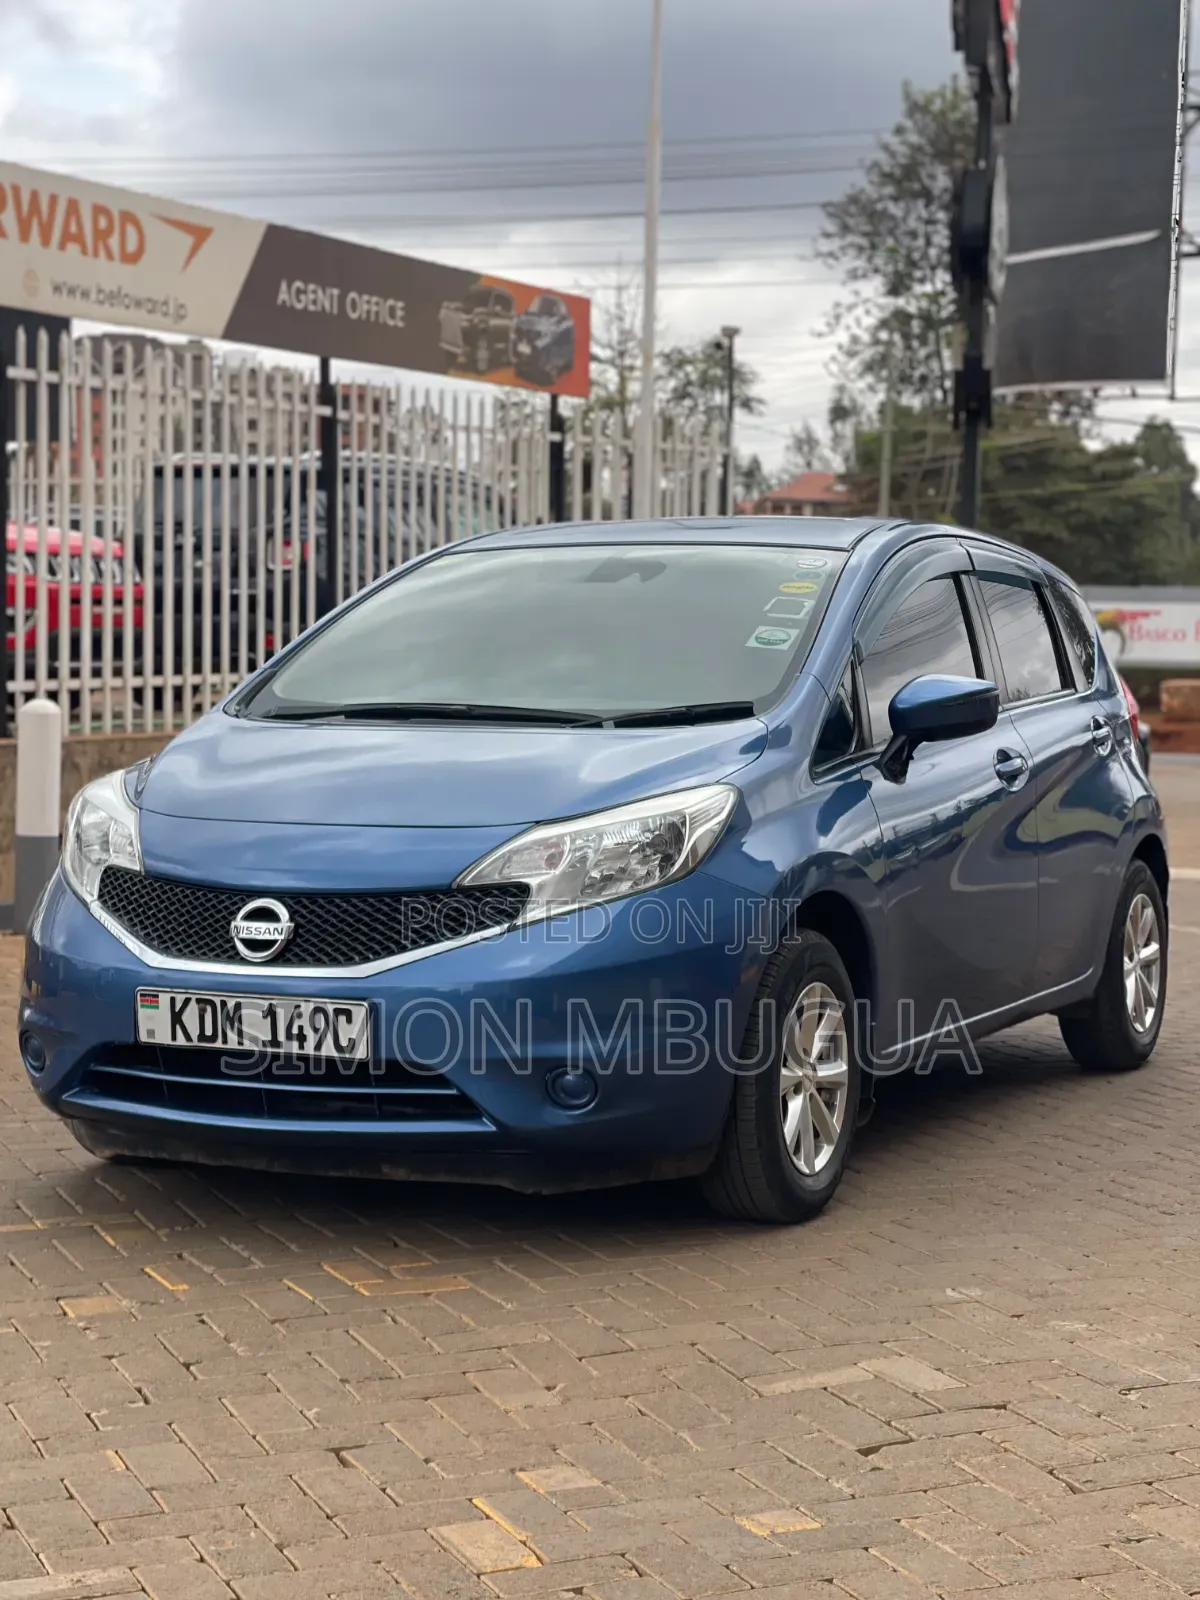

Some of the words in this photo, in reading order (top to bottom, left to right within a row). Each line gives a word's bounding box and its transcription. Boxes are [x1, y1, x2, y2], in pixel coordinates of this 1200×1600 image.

[276, 278, 341, 315] AGENT
[345, 290, 406, 328] OFFICE
[232, 925, 284, 937] NISSAN
[169, 996, 244, 1046] KDM
[261, 1002, 356, 1054] 149C
